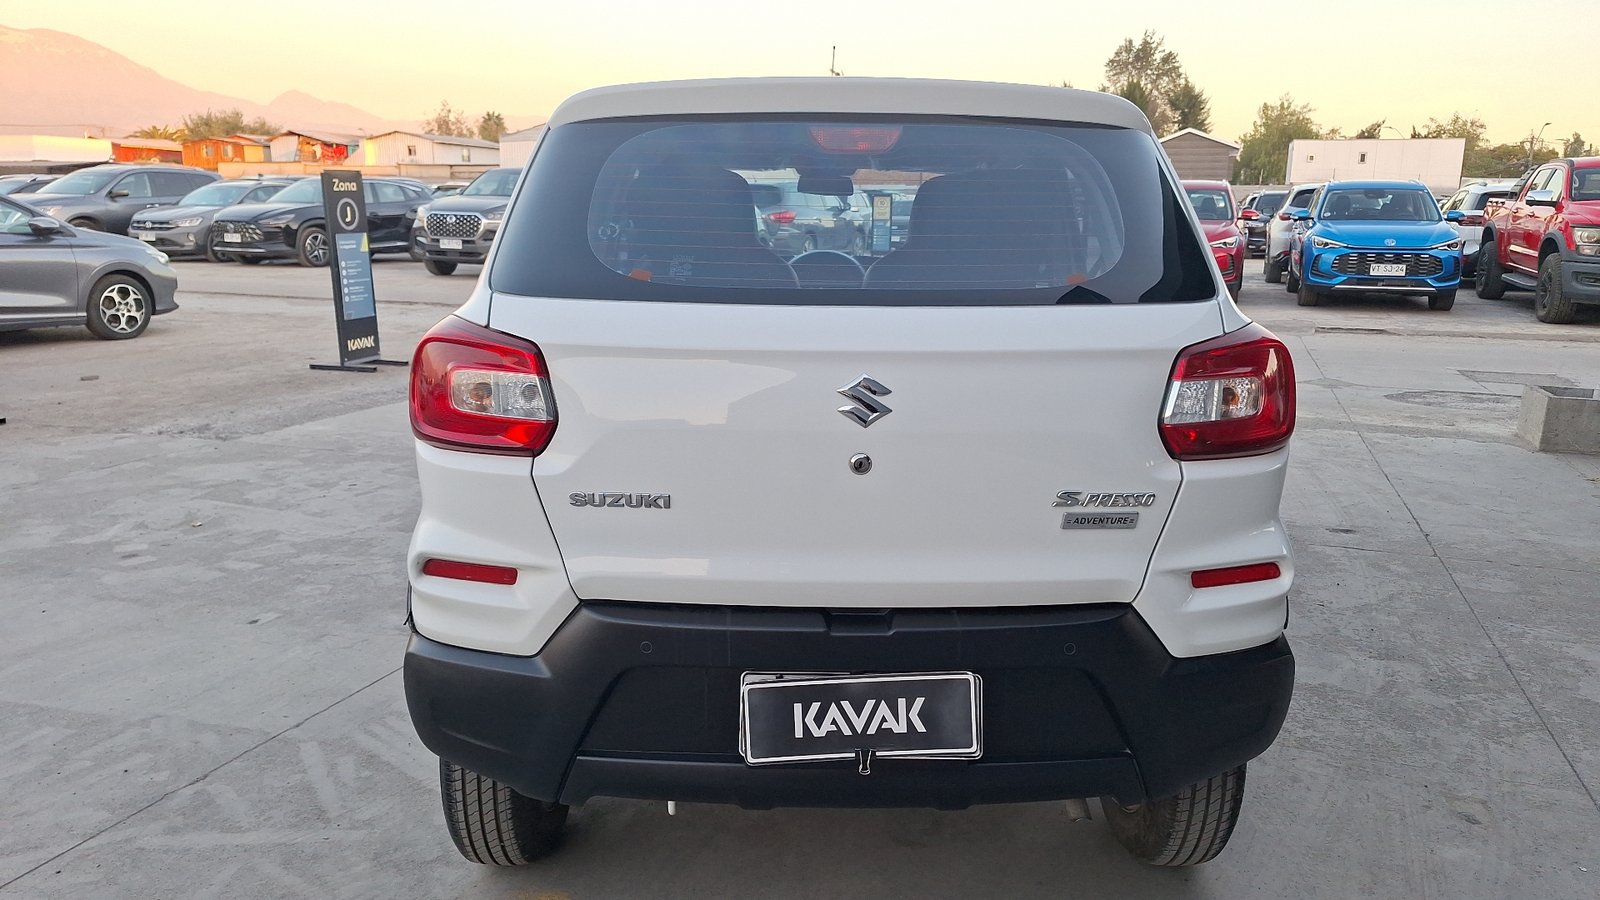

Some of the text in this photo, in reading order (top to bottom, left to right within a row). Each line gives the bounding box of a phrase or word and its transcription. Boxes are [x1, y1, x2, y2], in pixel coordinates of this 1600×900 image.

[332, 178, 357, 192] Zona
[345, 206, 352, 222] J
[347, 335, 375, 351] KAVAK
[568, 491, 671, 509] SUZUKI
[1073, 517, 1129, 525] ADVENTURE
[793, 696, 927, 738] KAVAK
